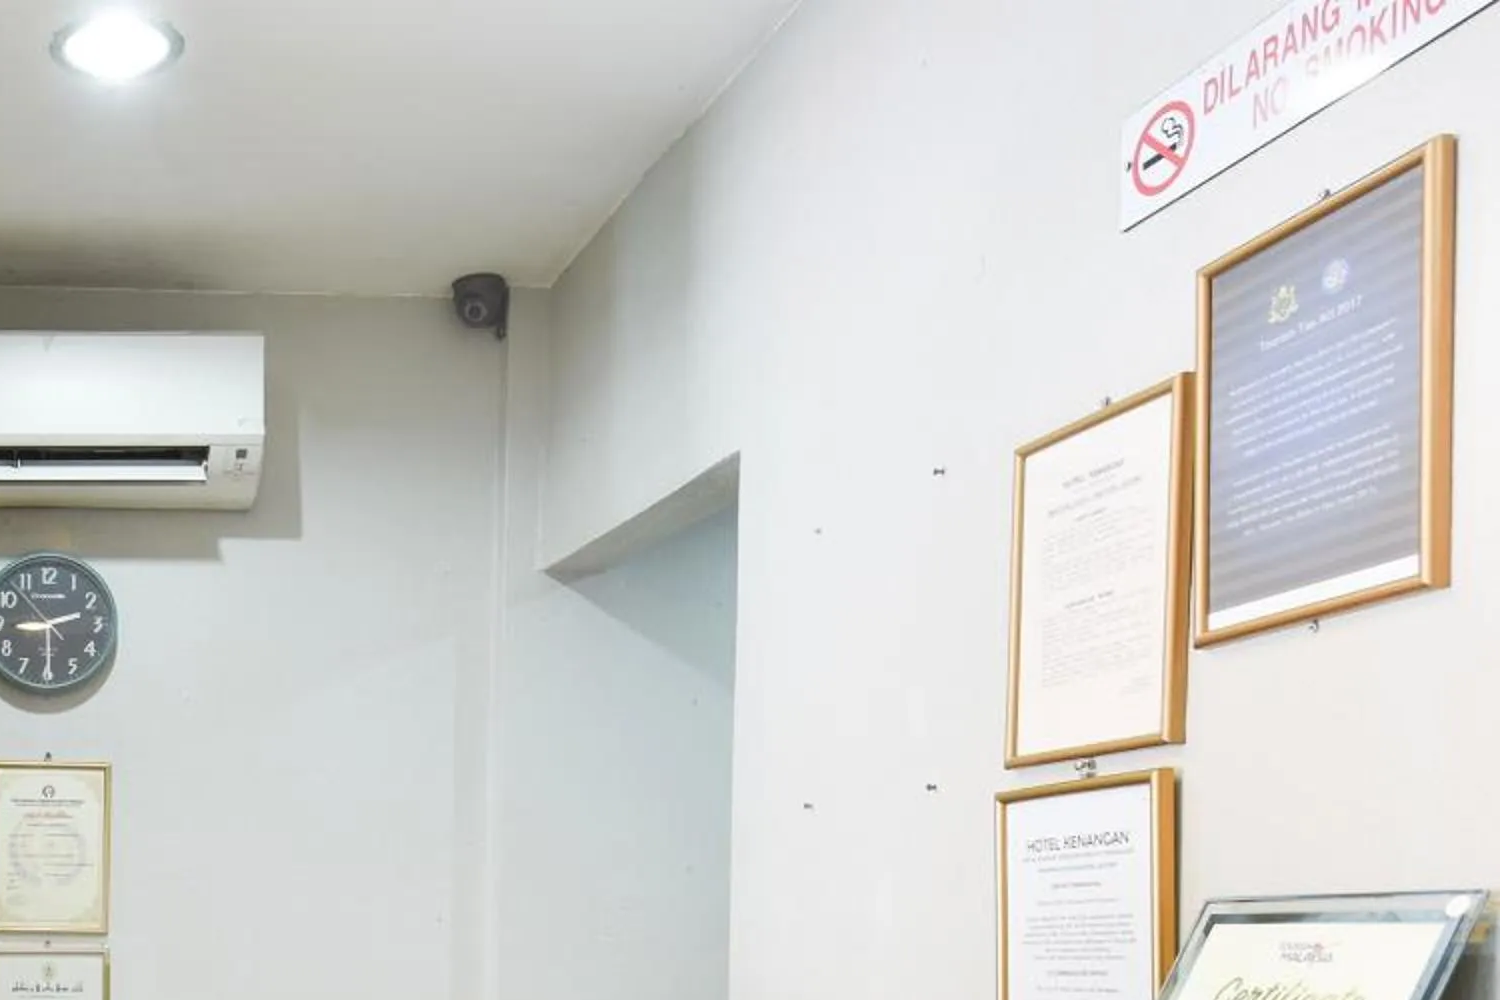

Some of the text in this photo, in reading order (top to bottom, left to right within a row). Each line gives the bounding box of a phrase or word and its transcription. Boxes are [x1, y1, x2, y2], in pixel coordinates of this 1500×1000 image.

[1203, 0, 1341, 115] DILARANG
[1253, 76, 1288, 129] NO
[20, 573, 32, 591] 11
[41, 567, 58, 585] 12
[70, 573, 77, 591] 1
[85, 591, 97, 609] 2
[93, 616, 104, 634] 3
[1, 639, 12, 657] 8
[84, 641, 97, 657] 4
[19, 657, 29, 675] 7
[68, 657, 78, 675] 5
[1027, 836, 1061, 853] HOTEL
